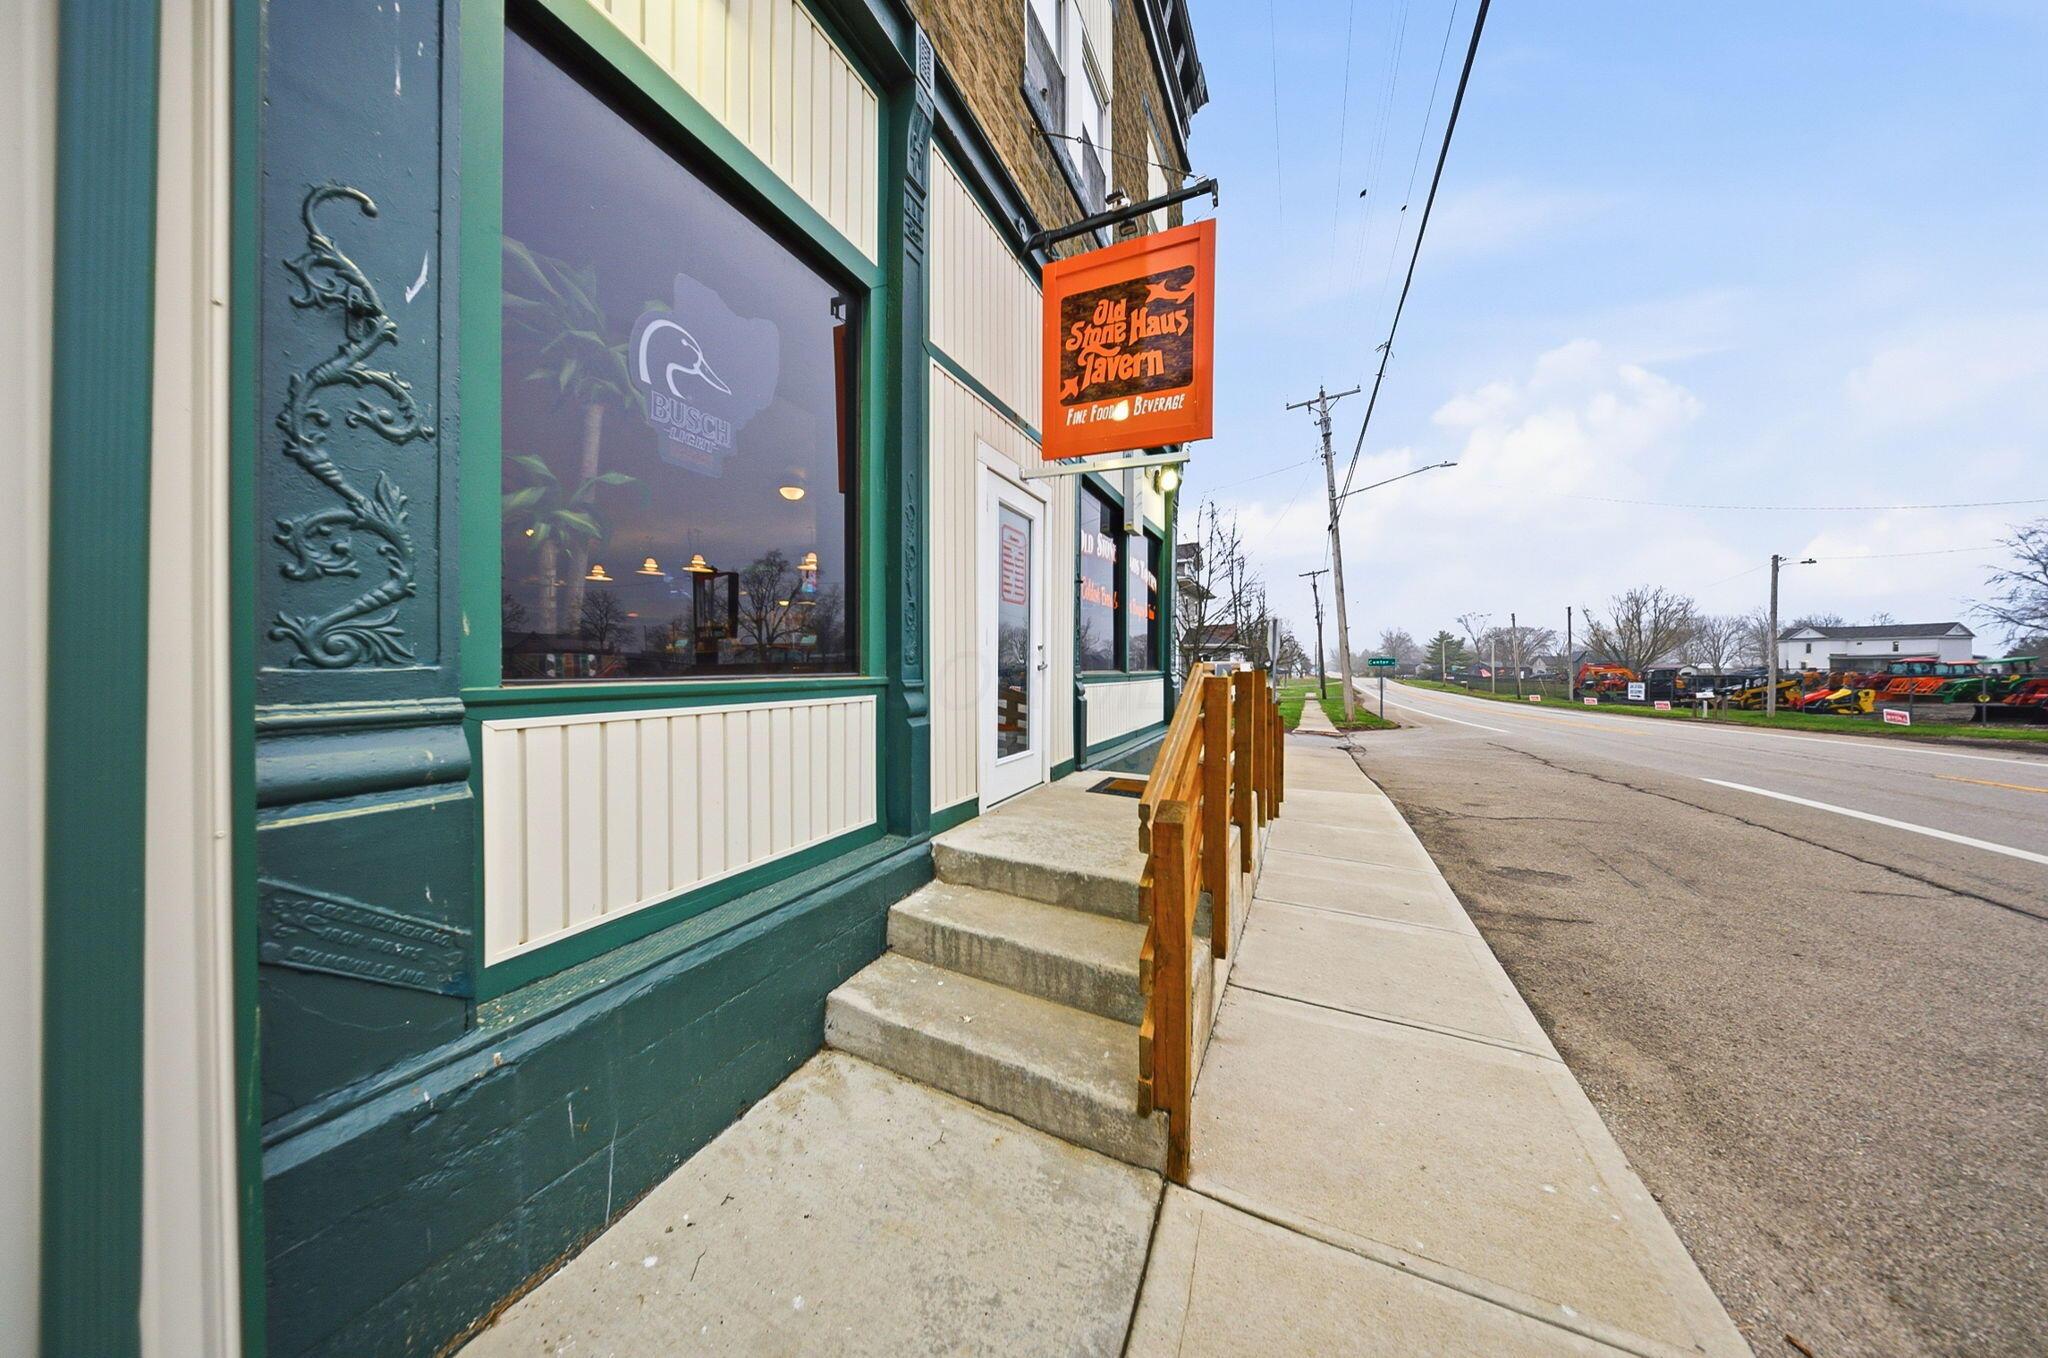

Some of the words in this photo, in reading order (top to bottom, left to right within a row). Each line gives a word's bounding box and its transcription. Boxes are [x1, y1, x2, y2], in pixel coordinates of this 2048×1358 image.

[1065, 320, 1127, 351] Stone
[1128, 307, 1189, 346] Haus
[1093, 299, 1127, 326] Old
[1077, 346, 1164, 391] Tavern
[650, 390, 732, 448] BUSCH
[1133, 393, 1186, 416] BEVERAGE
